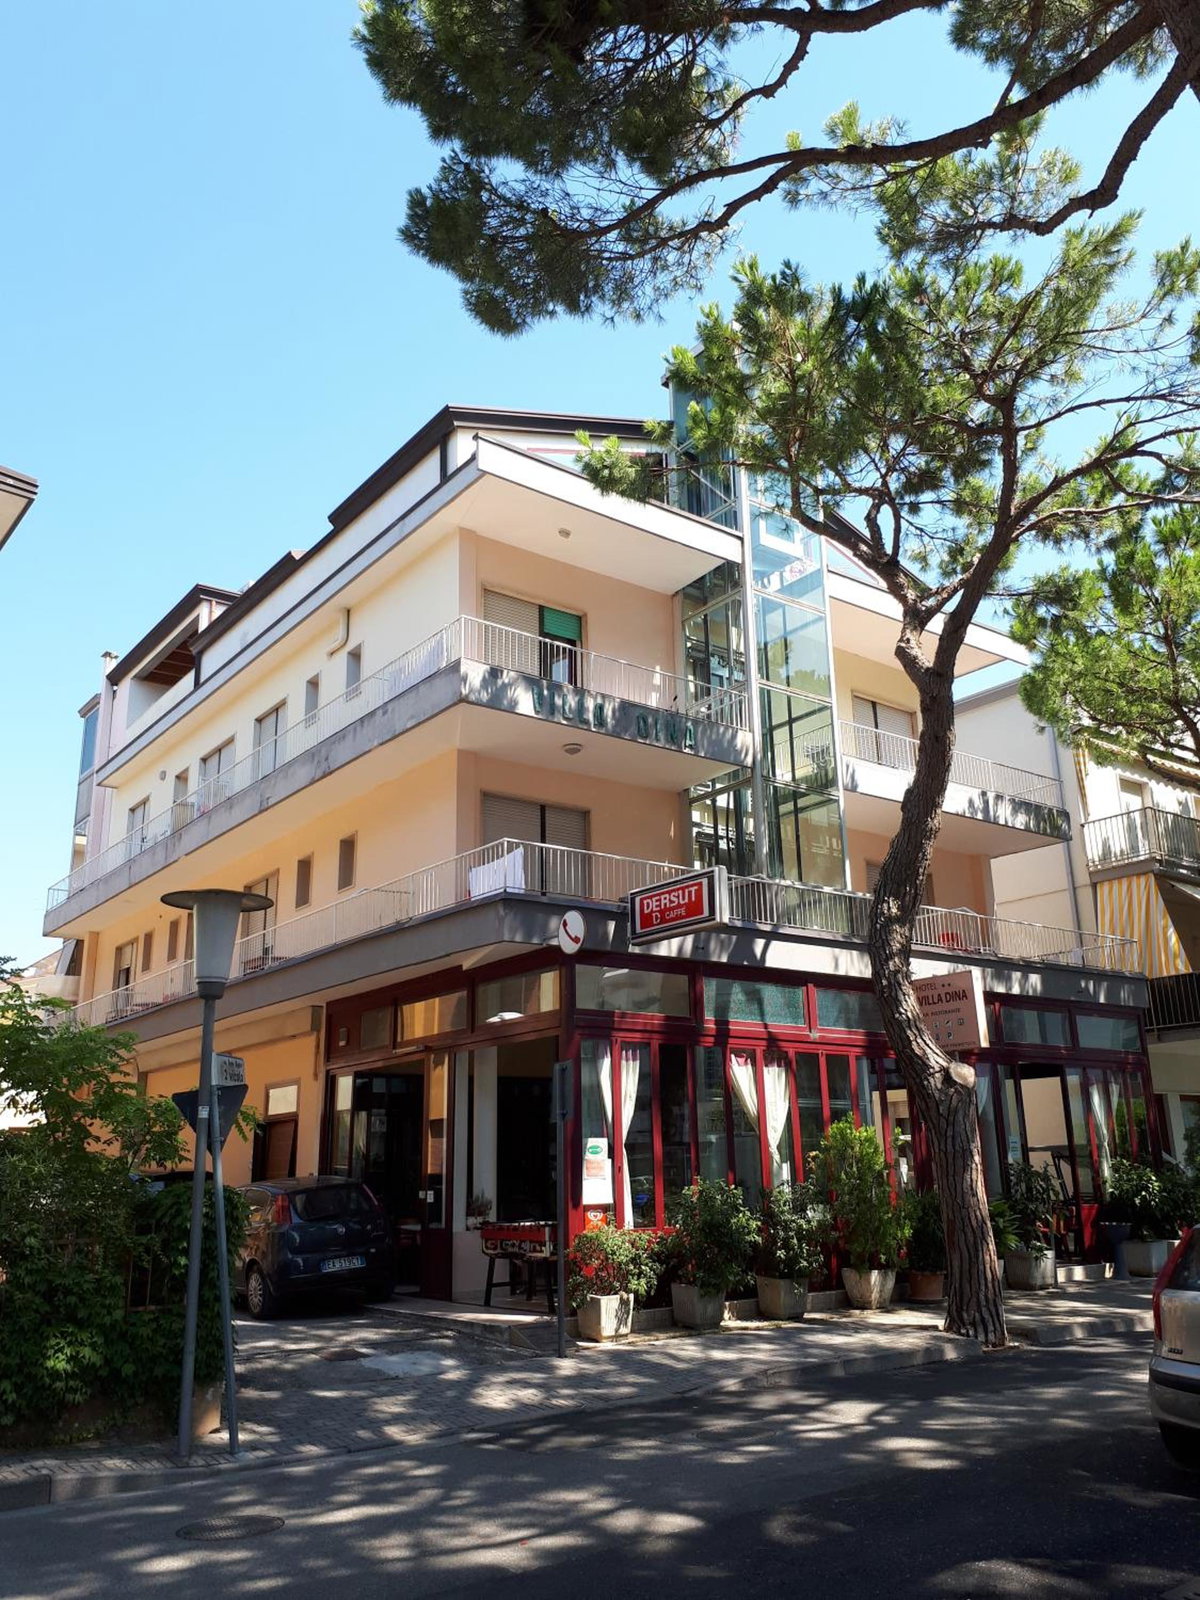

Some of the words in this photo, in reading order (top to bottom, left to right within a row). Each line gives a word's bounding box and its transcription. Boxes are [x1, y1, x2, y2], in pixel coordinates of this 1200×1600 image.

[643, 886, 698, 914] DERSUT
[915, 983, 937, 993] HOTEL
[917, 990, 943, 1007] VILLA
[944, 989, 969, 1004] DINA
